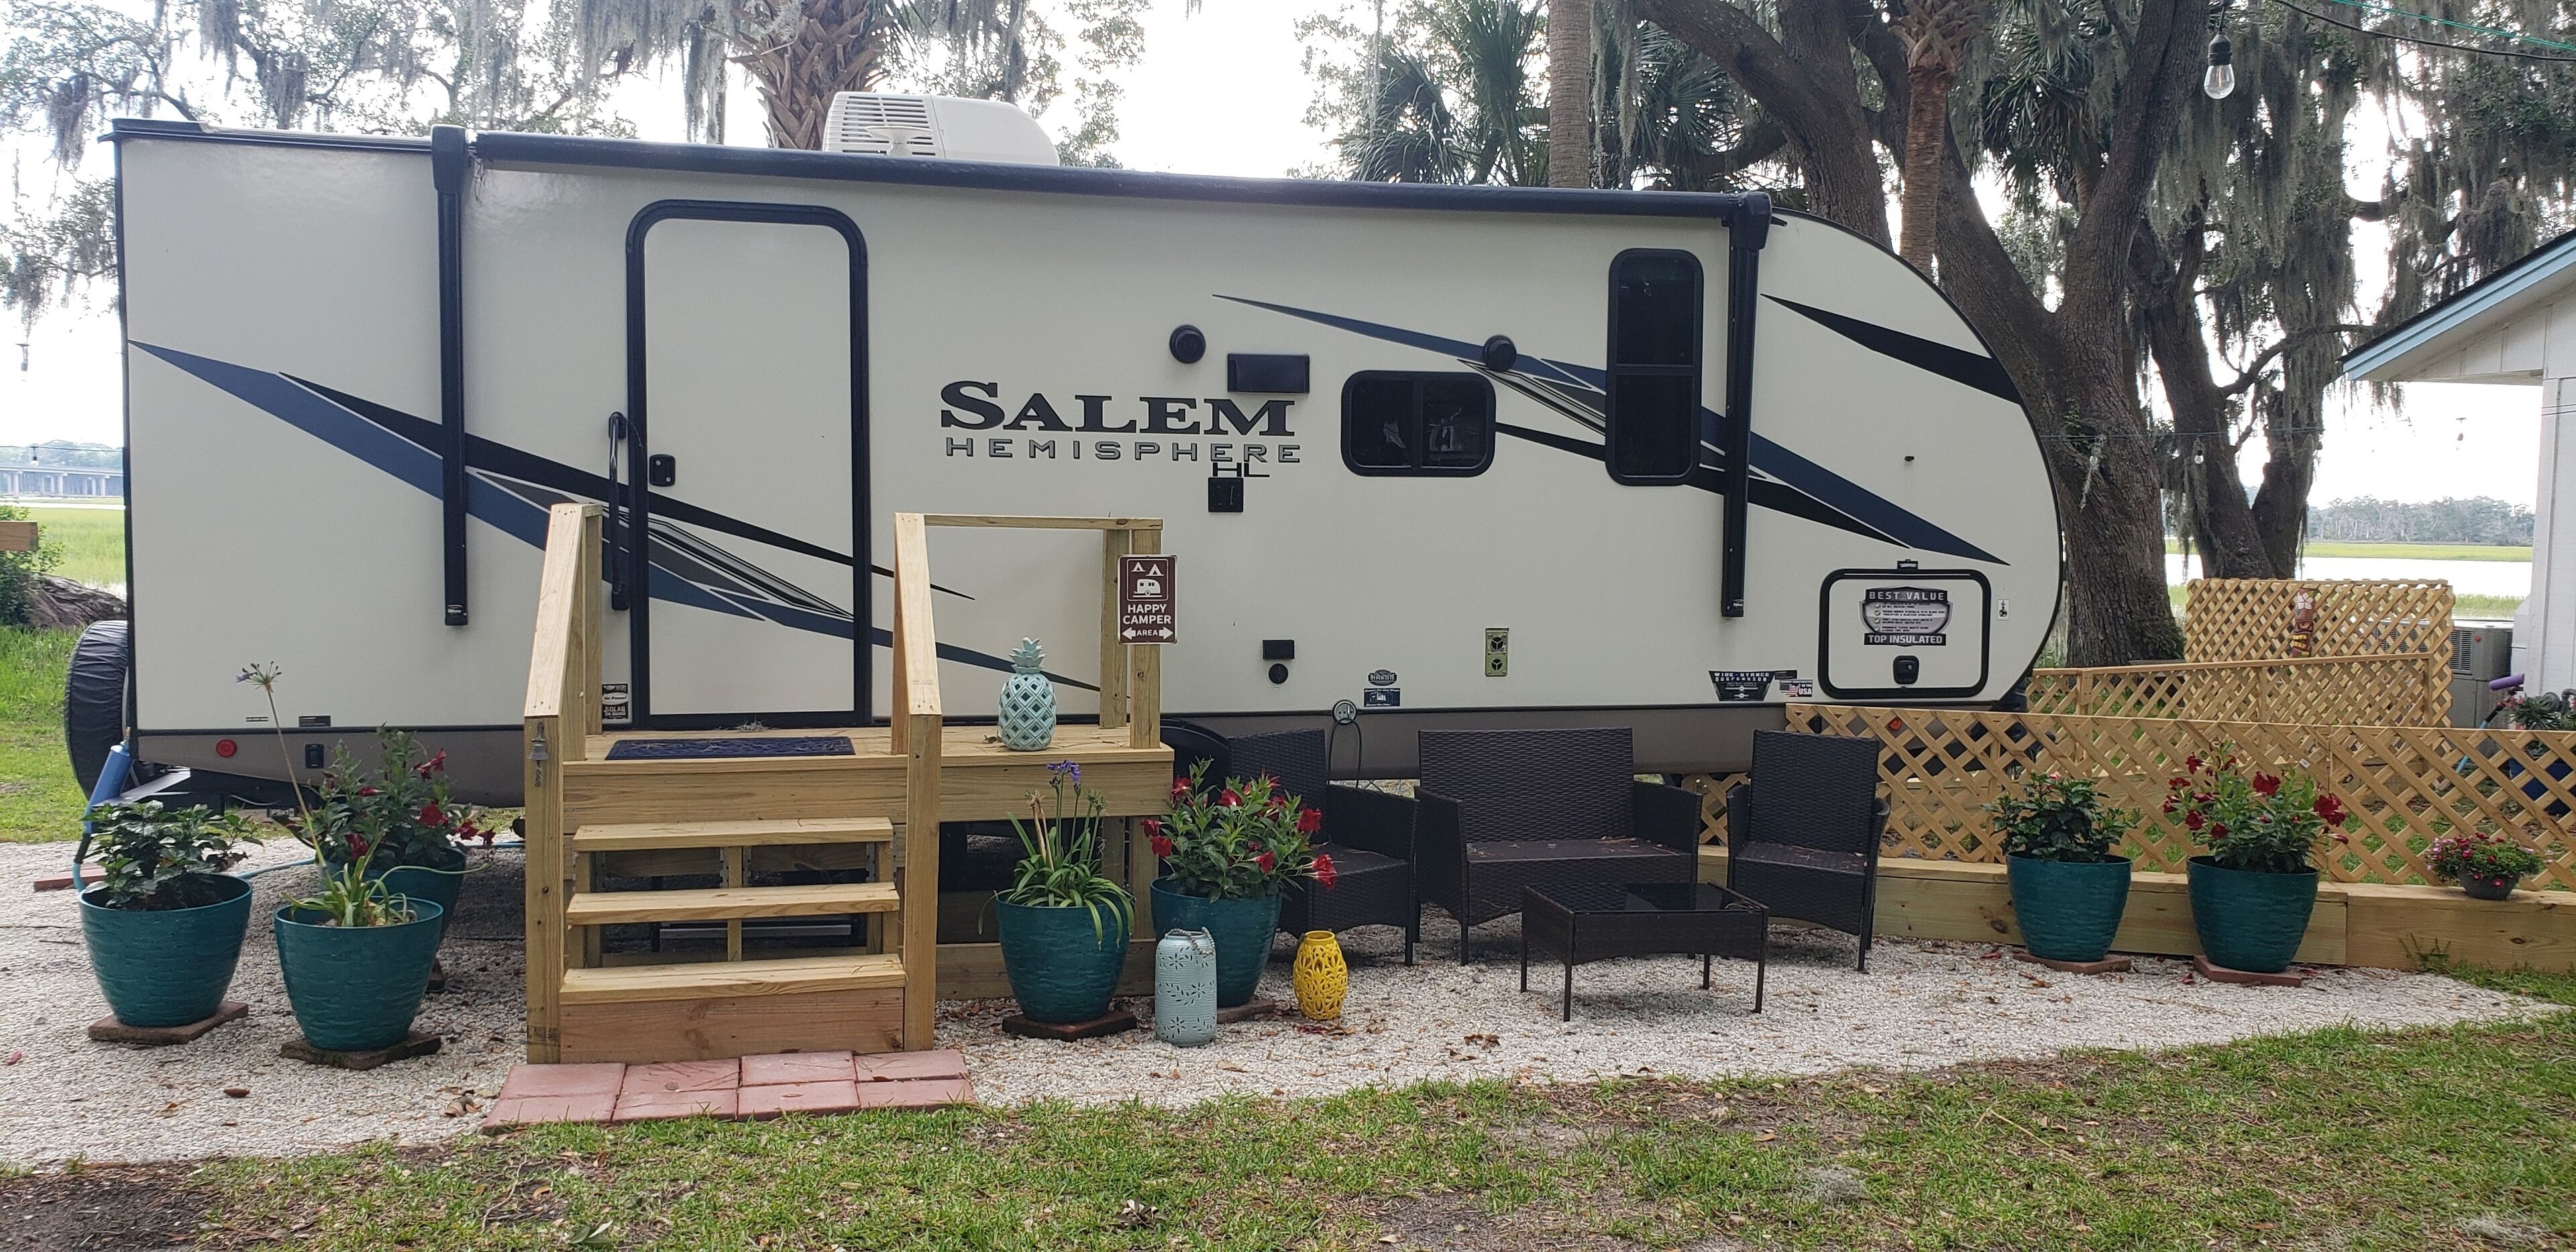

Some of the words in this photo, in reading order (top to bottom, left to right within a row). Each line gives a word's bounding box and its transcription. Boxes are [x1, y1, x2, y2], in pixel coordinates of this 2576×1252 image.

[940, 380, 1295, 436] SALEM
[946, 437, 1300, 463] HEMISPHERE
[1212, 462, 1270, 478] HL
[1869, 591, 1900, 600] BEST
[1906, 592, 1945, 601] VALUE
[1128, 604, 1167, 613] HAPPY
[1122, 615, 1172, 625] CAMPER
[1868, 635, 1887, 643] TOP
[1889, 635, 1943, 643] INSULATED
